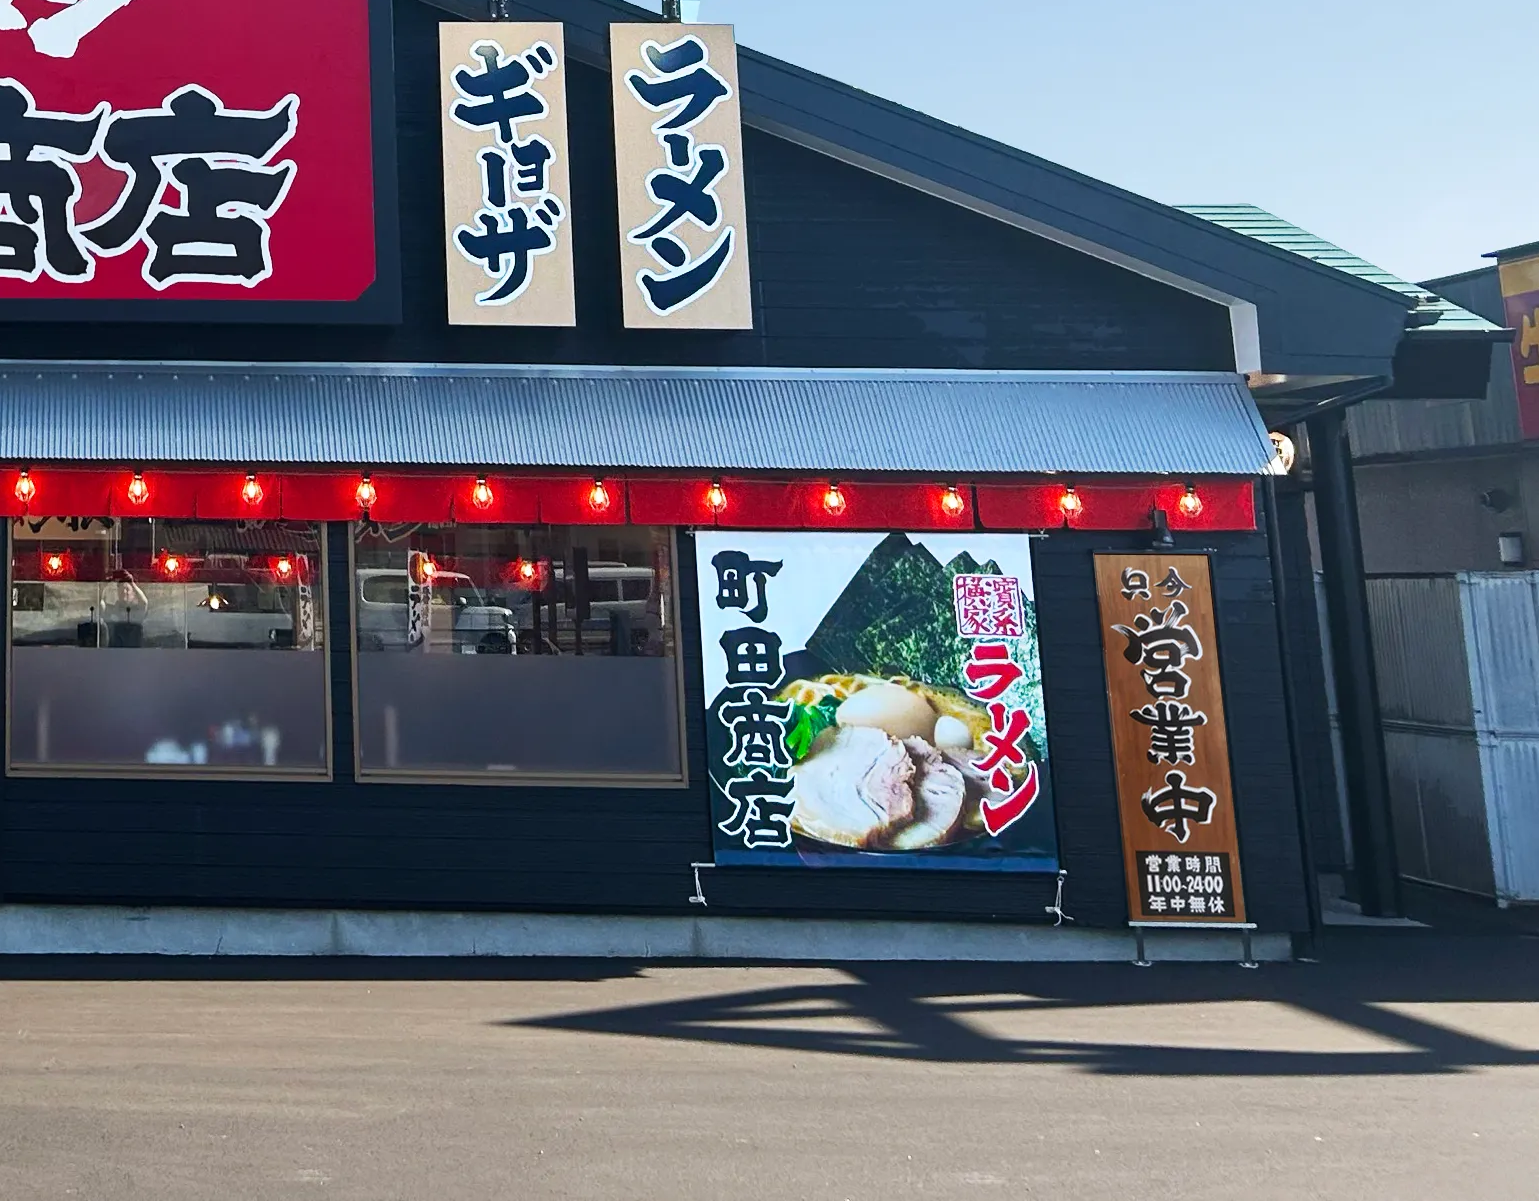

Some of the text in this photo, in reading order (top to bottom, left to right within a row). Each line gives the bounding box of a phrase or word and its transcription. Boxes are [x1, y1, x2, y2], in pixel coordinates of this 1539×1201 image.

[449, 39, 565, 306] ギョーザ
[624, 34, 735, 316] ラーメン
[711, 550, 796, 848] 町田商店
[963, 643, 1039, 836] ラーメン
[1111, 600, 1216, 843] 営業中
[1145, 854, 1221, 873] 営業時間
[1148, 895, 1225, 914] 年中無休
